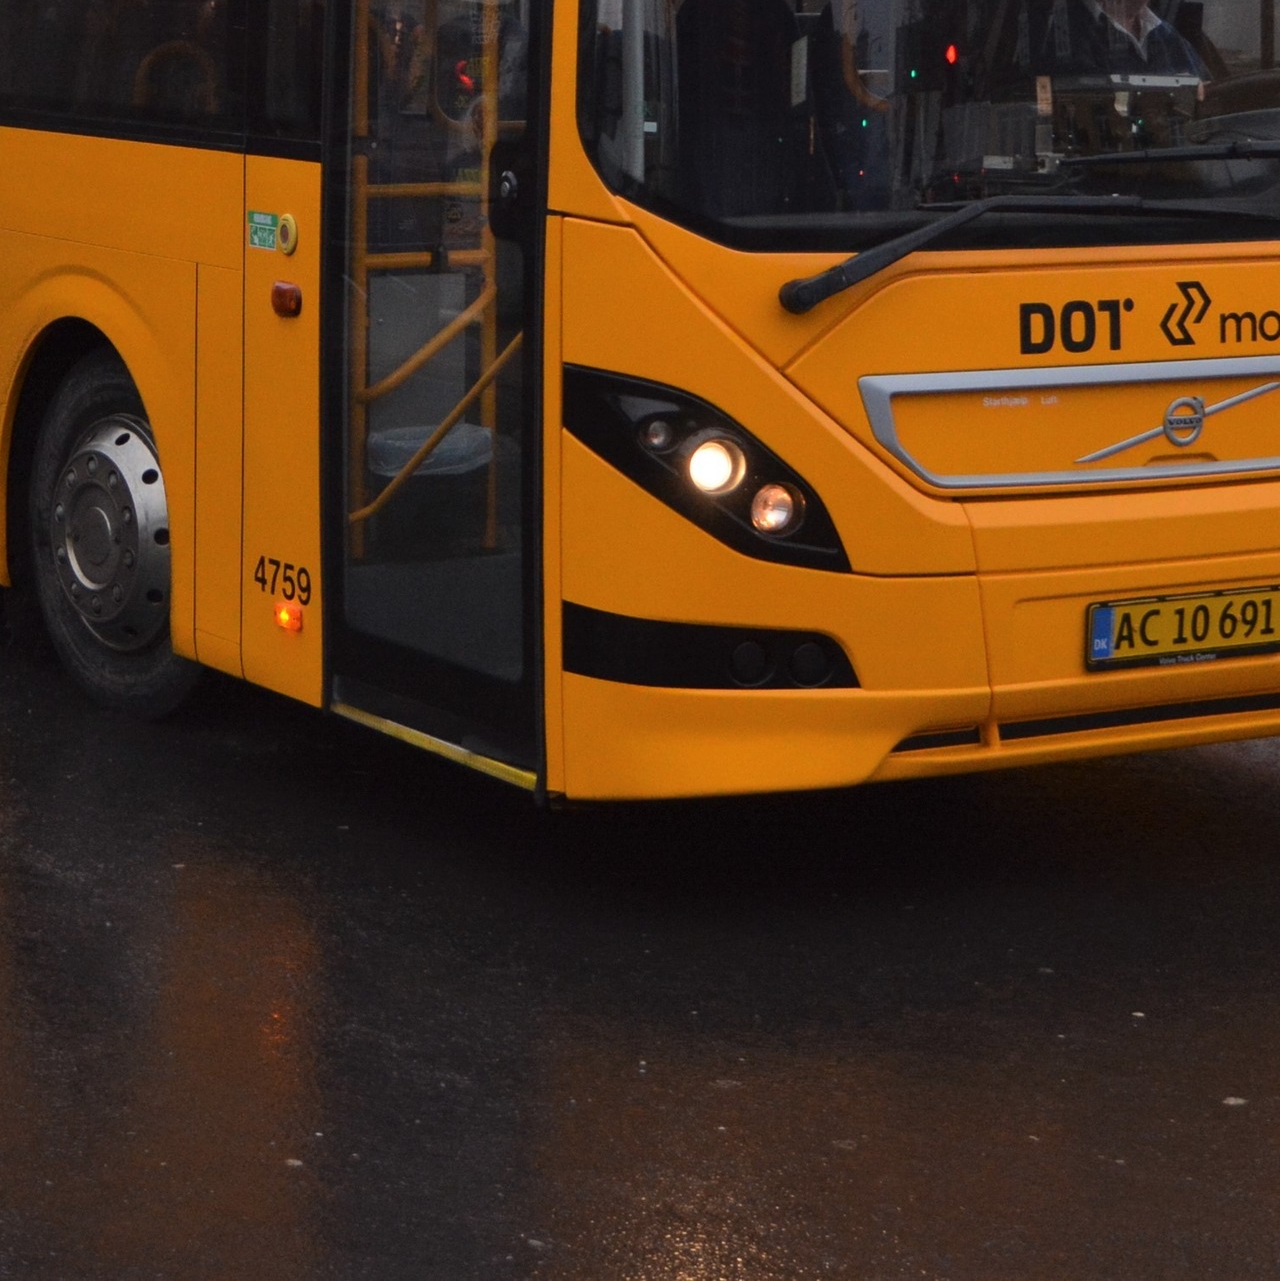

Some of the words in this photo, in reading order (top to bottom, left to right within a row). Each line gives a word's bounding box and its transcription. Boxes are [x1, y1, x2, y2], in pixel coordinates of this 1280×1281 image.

[1019, 298, 1135, 355] DOT
[1167, 417, 1203, 426] VOLVO
[254, 555, 311, 606] 4759
[1093, 638, 1108, 651] DK
[1114, 609, 1161, 650] AC
[1172, 604, 1210, 645] 10
[1218, 598, 1275, 639] 691
